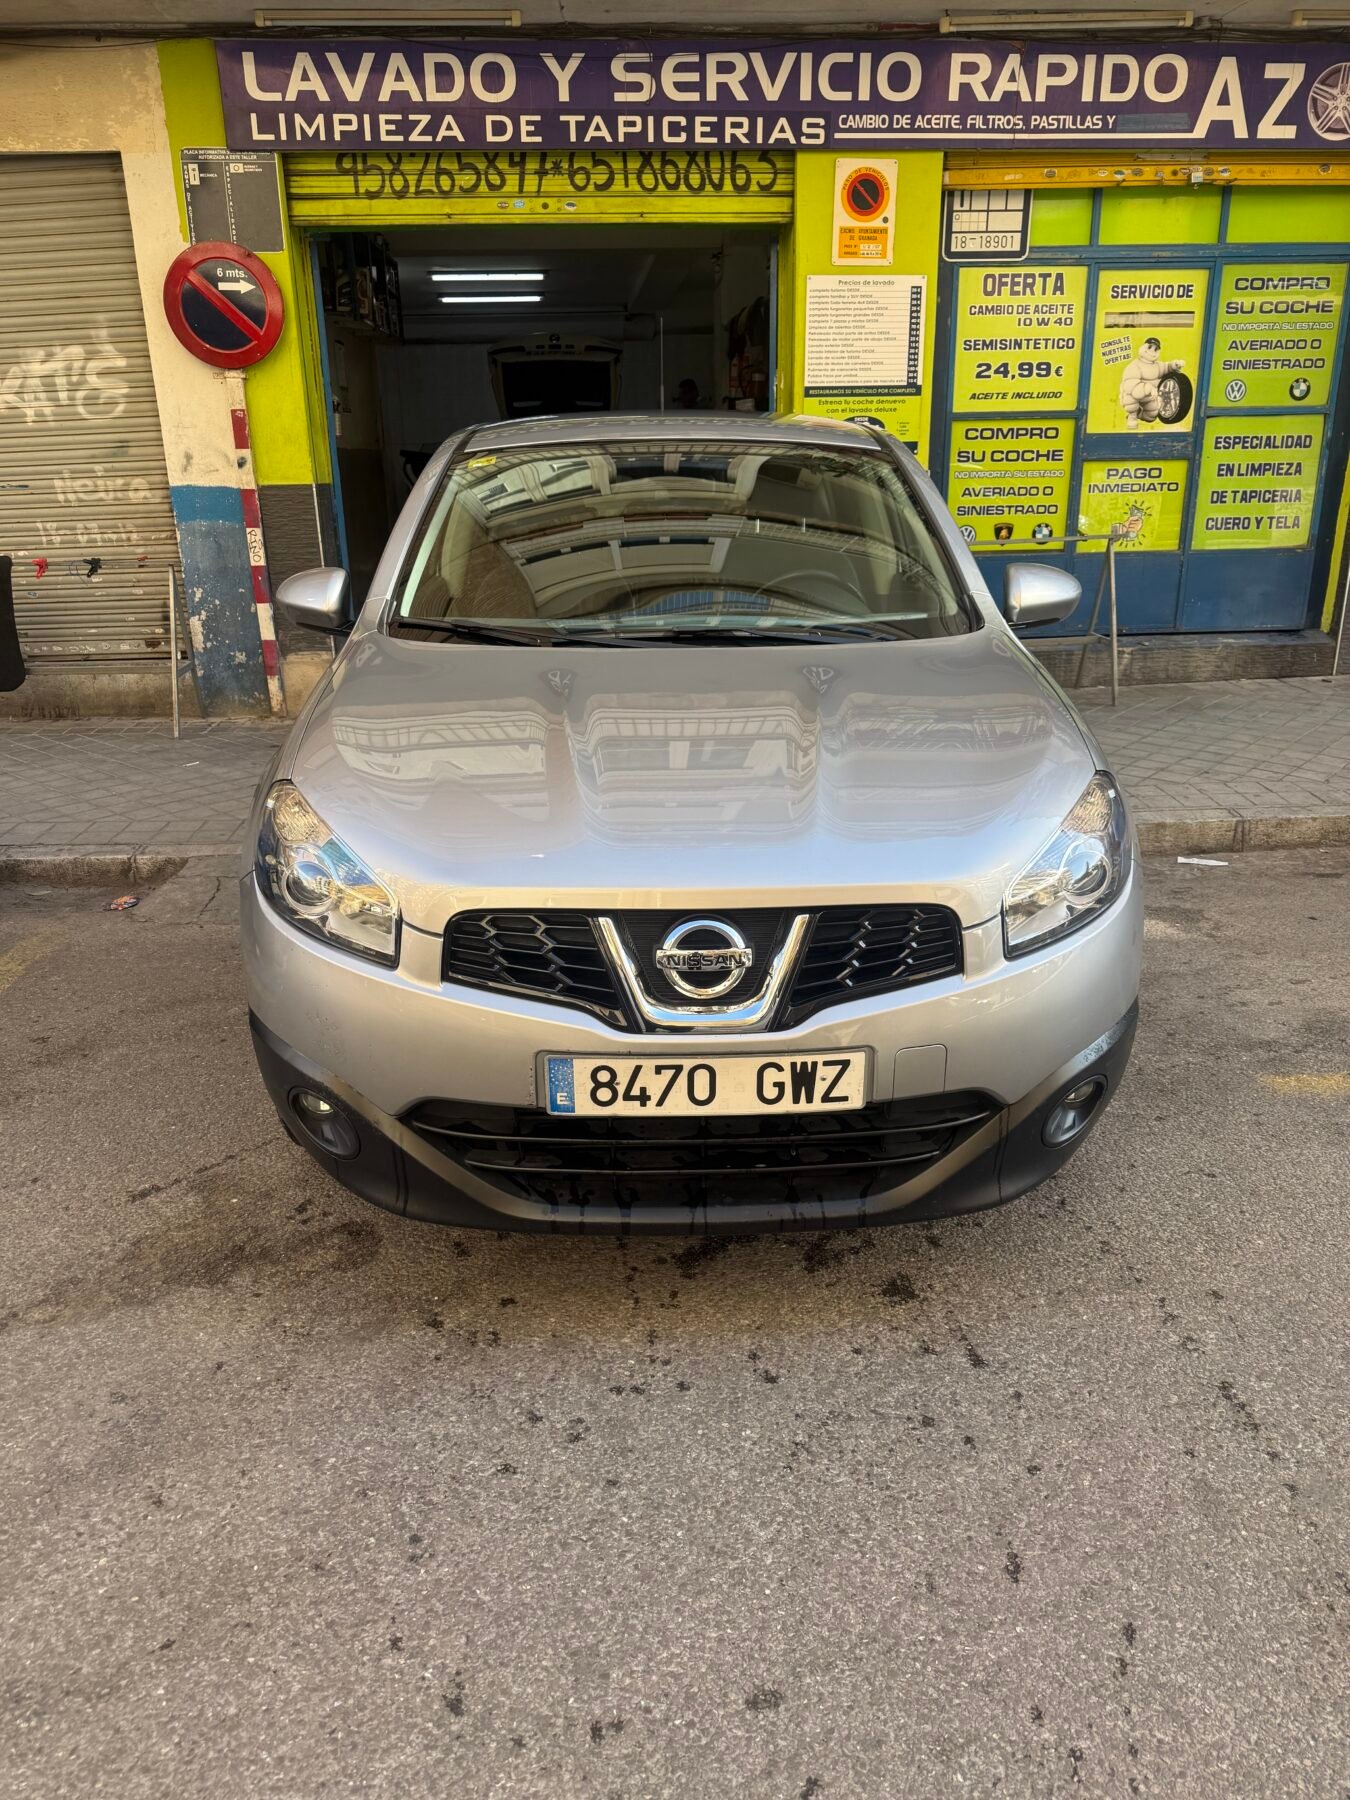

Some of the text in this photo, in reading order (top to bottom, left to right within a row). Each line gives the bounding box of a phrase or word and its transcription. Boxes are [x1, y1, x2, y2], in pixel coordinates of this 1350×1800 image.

[242, 52, 1188, 103] LAVADO Y SERVICIO RAPIDO
[250, 113, 825, 145] LIMPIEZA DE TAPICERIAS
[839, 114, 1116, 131] CAMBIO DE ACEITE, FILTROS, PASTILLAS Y
[955, 236, 1014, 248] 18-18901
[217, 268, 248, 278] 6 mts.
[982, 272, 1065, 296] OFERTA
[1234, 277, 1330, 291] COMPRO
[1111, 284, 1194, 299] SERVICIO DE
[969, 304, 1074, 316] CAMBIO DE ACEITE
[1226, 300, 1334, 314] SU COCHE
[1036, 318, 1050, 326] W
[1054, 317, 1073, 326] 40
[1222, 323, 1236, 331] NO
[1282, 322, 1295, 330] SU
[963, 338, 1075, 351] SEMISINTETICO
[1101, 336, 1130, 348] CONSULTE
[1228, 339, 1321, 350] AVERIADO O
[1102, 345, 1132, 357] NUESTRAS
[1222, 358, 1325, 370] SINIESTRADO
[969, 391, 1062, 400] ACEITE INCLUIDO
[965, 427, 1059, 440] COMPRO
[1214, 435, 1312, 449] ESPECIALIDAD
[957, 449, 1064, 463] SU COCHE
[954, 471, 968, 479] NO
[1106, 468, 1162, 479] PAGO
[1217, 462, 1302, 477] EN LIMPIEZA
[961, 486, 1054, 497] AVERIADO O
[1088, 482, 1179, 493] INMEDIATO
[1210, 489, 1302, 504] DE TAPICERIA
[956, 505, 1058, 516] SINIESTRADO
[1205, 516, 1300, 530] CUERO Y TELA
[666, 954, 744, 968] NISSAN
[590, 1059, 851, 1107] 8470 GWZ
[556, 1092, 570, 1105] E
